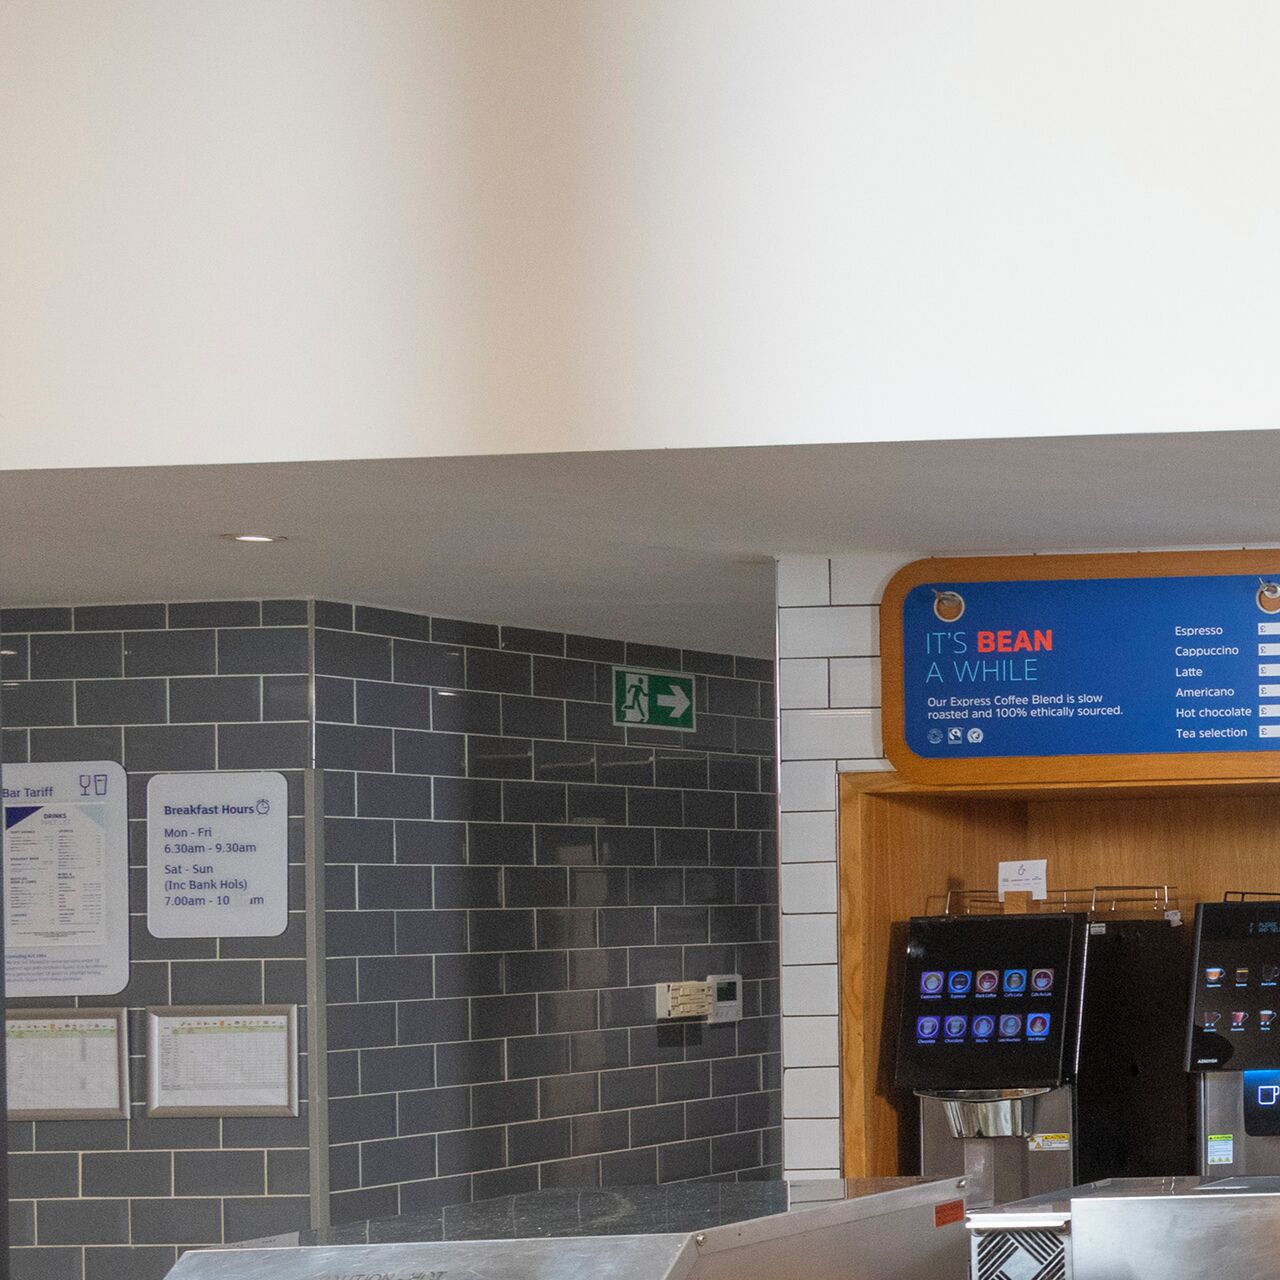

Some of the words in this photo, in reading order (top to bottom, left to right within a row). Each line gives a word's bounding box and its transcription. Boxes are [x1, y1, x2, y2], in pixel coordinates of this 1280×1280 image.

[1175, 626, 1223, 637] Espresso
[926, 631, 968, 654] IT'S
[977, 629, 1053, 653] BEAN
[1175, 646, 1239, 657] Cappuccino
[926, 661, 944, 683] A
[953, 658, 1038, 682] WHILE
[1176, 667, 1203, 677] Latte
[1176, 687, 1235, 697] Americano
[928, 697, 947, 707] Our
[951, 696, 991, 708] Express
[994, 695, 1029, 706] Coffee
[1032, 694, 1063, 704] Blend
[1067, 694, 1074, 703] is
[1078, 693, 1103, 703] slow
[928, 710, 968, 720] roasted
[972, 708, 993, 718] and
[996, 708, 1027, 718] 100%
[1030, 707, 1075, 718] ethically
[1077, 705, 1123, 716] sourced.
[1176, 708, 1196, 718] Hot
[1199, 707, 1252, 717] chocolate
[1176, 729, 1196, 738] Tea
[1199, 728, 1248, 738] selection
[2, 788, 21, 798] Bar
[25, 786, 53, 798] Tariff
[164, 804, 218, 815] Breakfast
[221, 804, 255, 815] Hours
[164, 828, 188, 838] Mon
[198, 827, 212, 837] Fri
[164, 843, 205, 854] 6.30am
[215, 843, 256, 853] 9.30am
[164, 864, 182, 874] Sat
[192, 864, 213, 874] Sun
[164, 880, 186, 891] (Inc
[189, 879, 217, 890] Bank
[220, 879, 248, 891] Hols)
[164, 896, 206, 906] 7.00am
